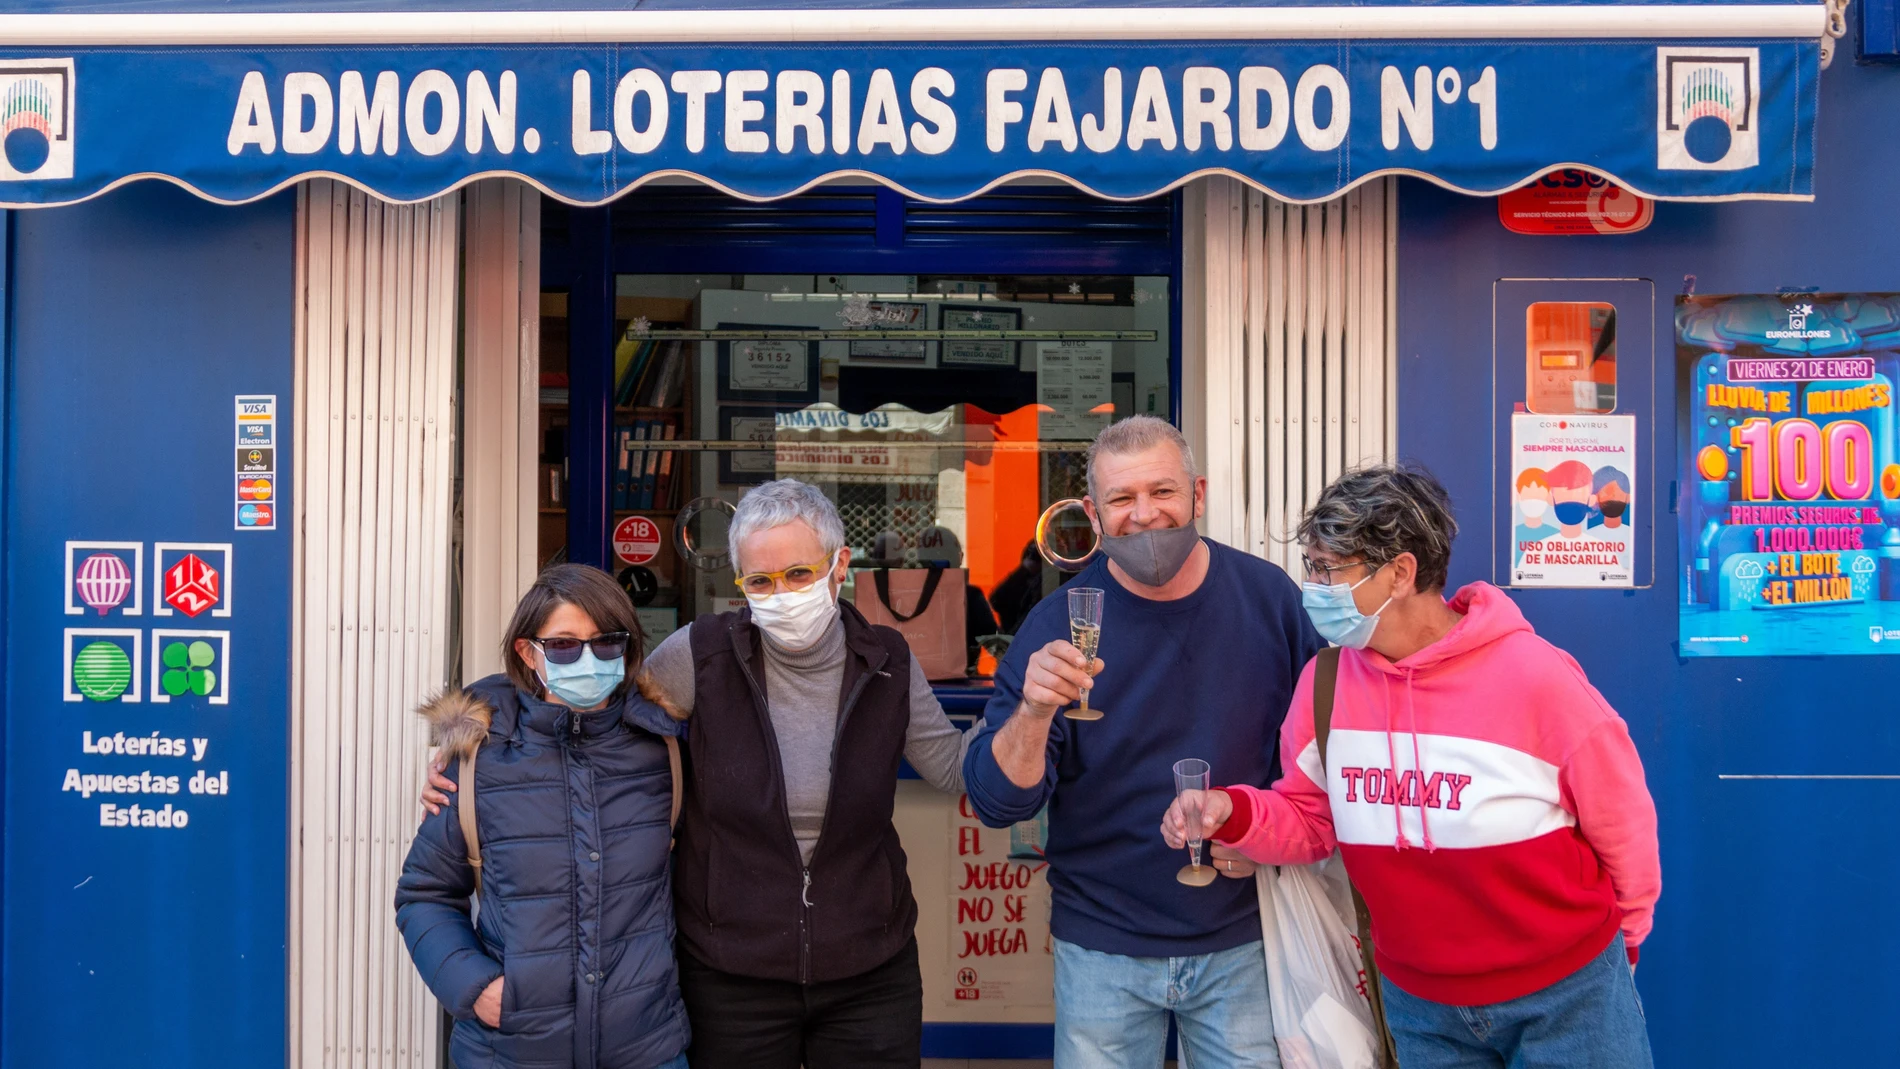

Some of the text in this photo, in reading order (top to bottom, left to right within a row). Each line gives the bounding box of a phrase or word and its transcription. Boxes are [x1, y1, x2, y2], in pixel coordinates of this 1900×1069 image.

[227, 69, 540, 156] ADMON.
[572, 67, 957, 156] LOTERIAS
[986, 64, 1351, 153] FAJARDO
[1542, 210, 1567, 218] TÉCNICO
[1766, 330, 1831, 339] EUROMILLONES
[1735, 360, 1868, 379] VIERNES 21 DE ENERO
[243, 404, 267, 414] VISA
[1707, 383, 1890, 414] LLUVIA DE MILLONES
[246, 425, 264, 433] VISA
[240, 437, 270, 445] Electron
[1523, 444, 1625, 453] SIEMPRE MASCARILLA
[243, 463, 267, 471] ServiRed
[1730, 417, 1874, 502] 100
[239, 486, 272, 494] MasterCard
[1731, 505, 1882, 525] PREMIOS SEGUROS DE
[623, 522, 649, 537] +18
[1754, 526, 1864, 553] 1.000.000€
[1519, 541, 1625, 553] USO OBLIGATORIO
[1526, 554, 1618, 565] DE MASCARILLA
[1779, 554, 1799, 577] EL
[1802, 552, 1841, 575] BOTE
[1793, 573, 1853, 604] MILLÓN
[83, 730, 208, 761] Loterías y
[62, 768, 229, 799] Apuestas del
[1341, 766, 1472, 811] TOMMY
[100, 803, 189, 828] Estado
[958, 825, 984, 856] EL
[957, 861, 1031, 891] JUEGO
[957, 894, 1028, 925] NO SE
[957, 927, 1028, 959] JUEGA
[957, 988, 977, 999] +18
